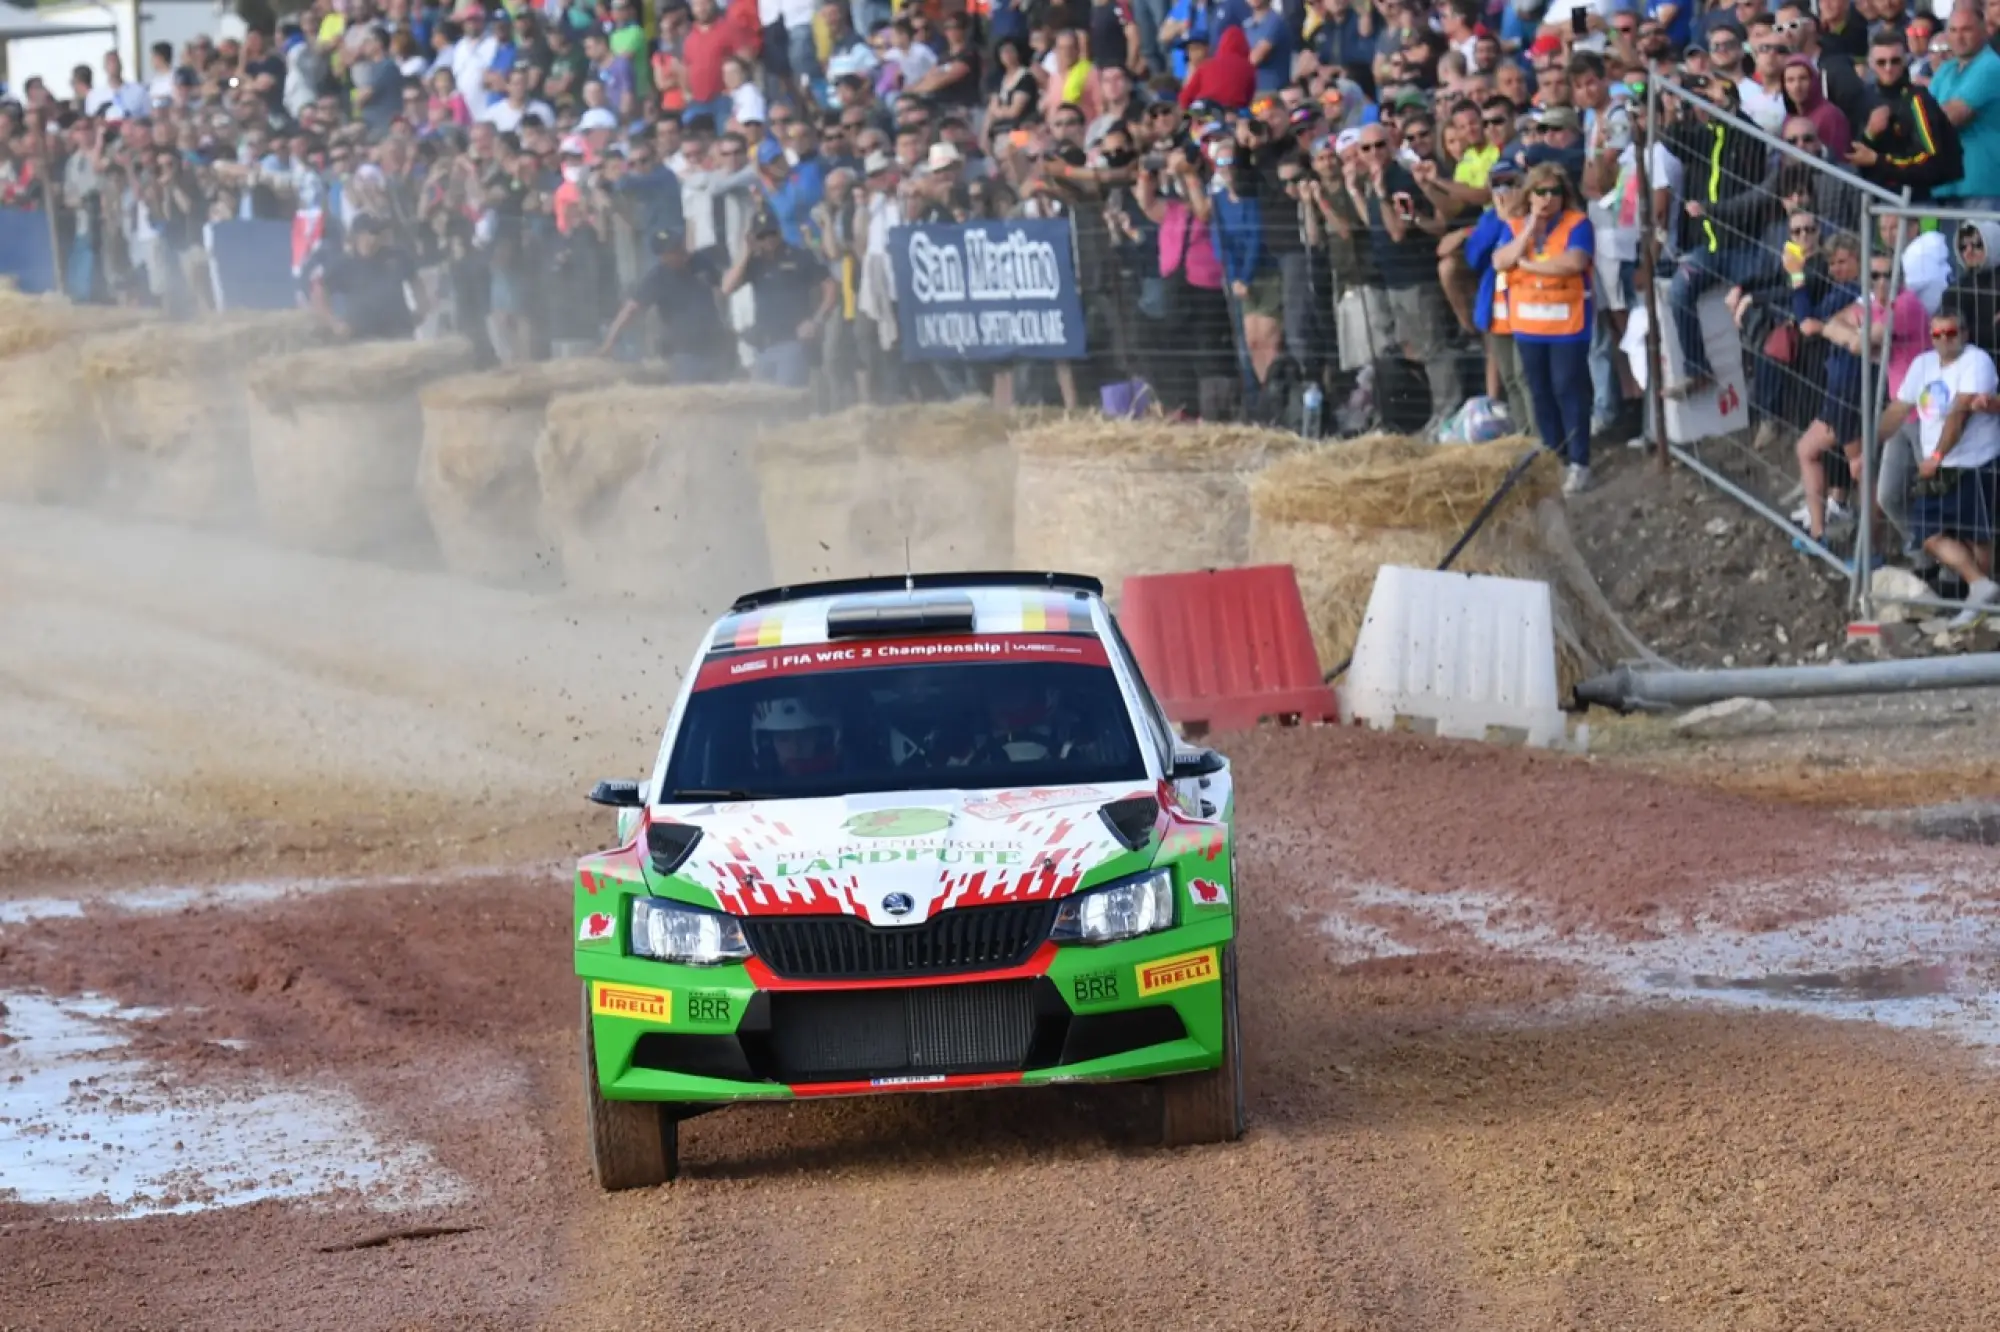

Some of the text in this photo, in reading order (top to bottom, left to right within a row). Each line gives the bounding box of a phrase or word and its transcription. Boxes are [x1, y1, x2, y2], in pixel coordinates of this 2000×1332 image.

[909, 228, 1060, 303] San Martino
[782, 653, 812, 666] FIA
[816, 649, 856, 662] WRC
[861, 647, 873, 658] 2
[877, 641, 1001, 657] Championship
[1143, 955, 1212, 990] PIRELLI
[599, 987, 665, 1016] PIRELLI
[1074, 976, 1119, 1001] BRR
[688, 998, 731, 1020] BRR
